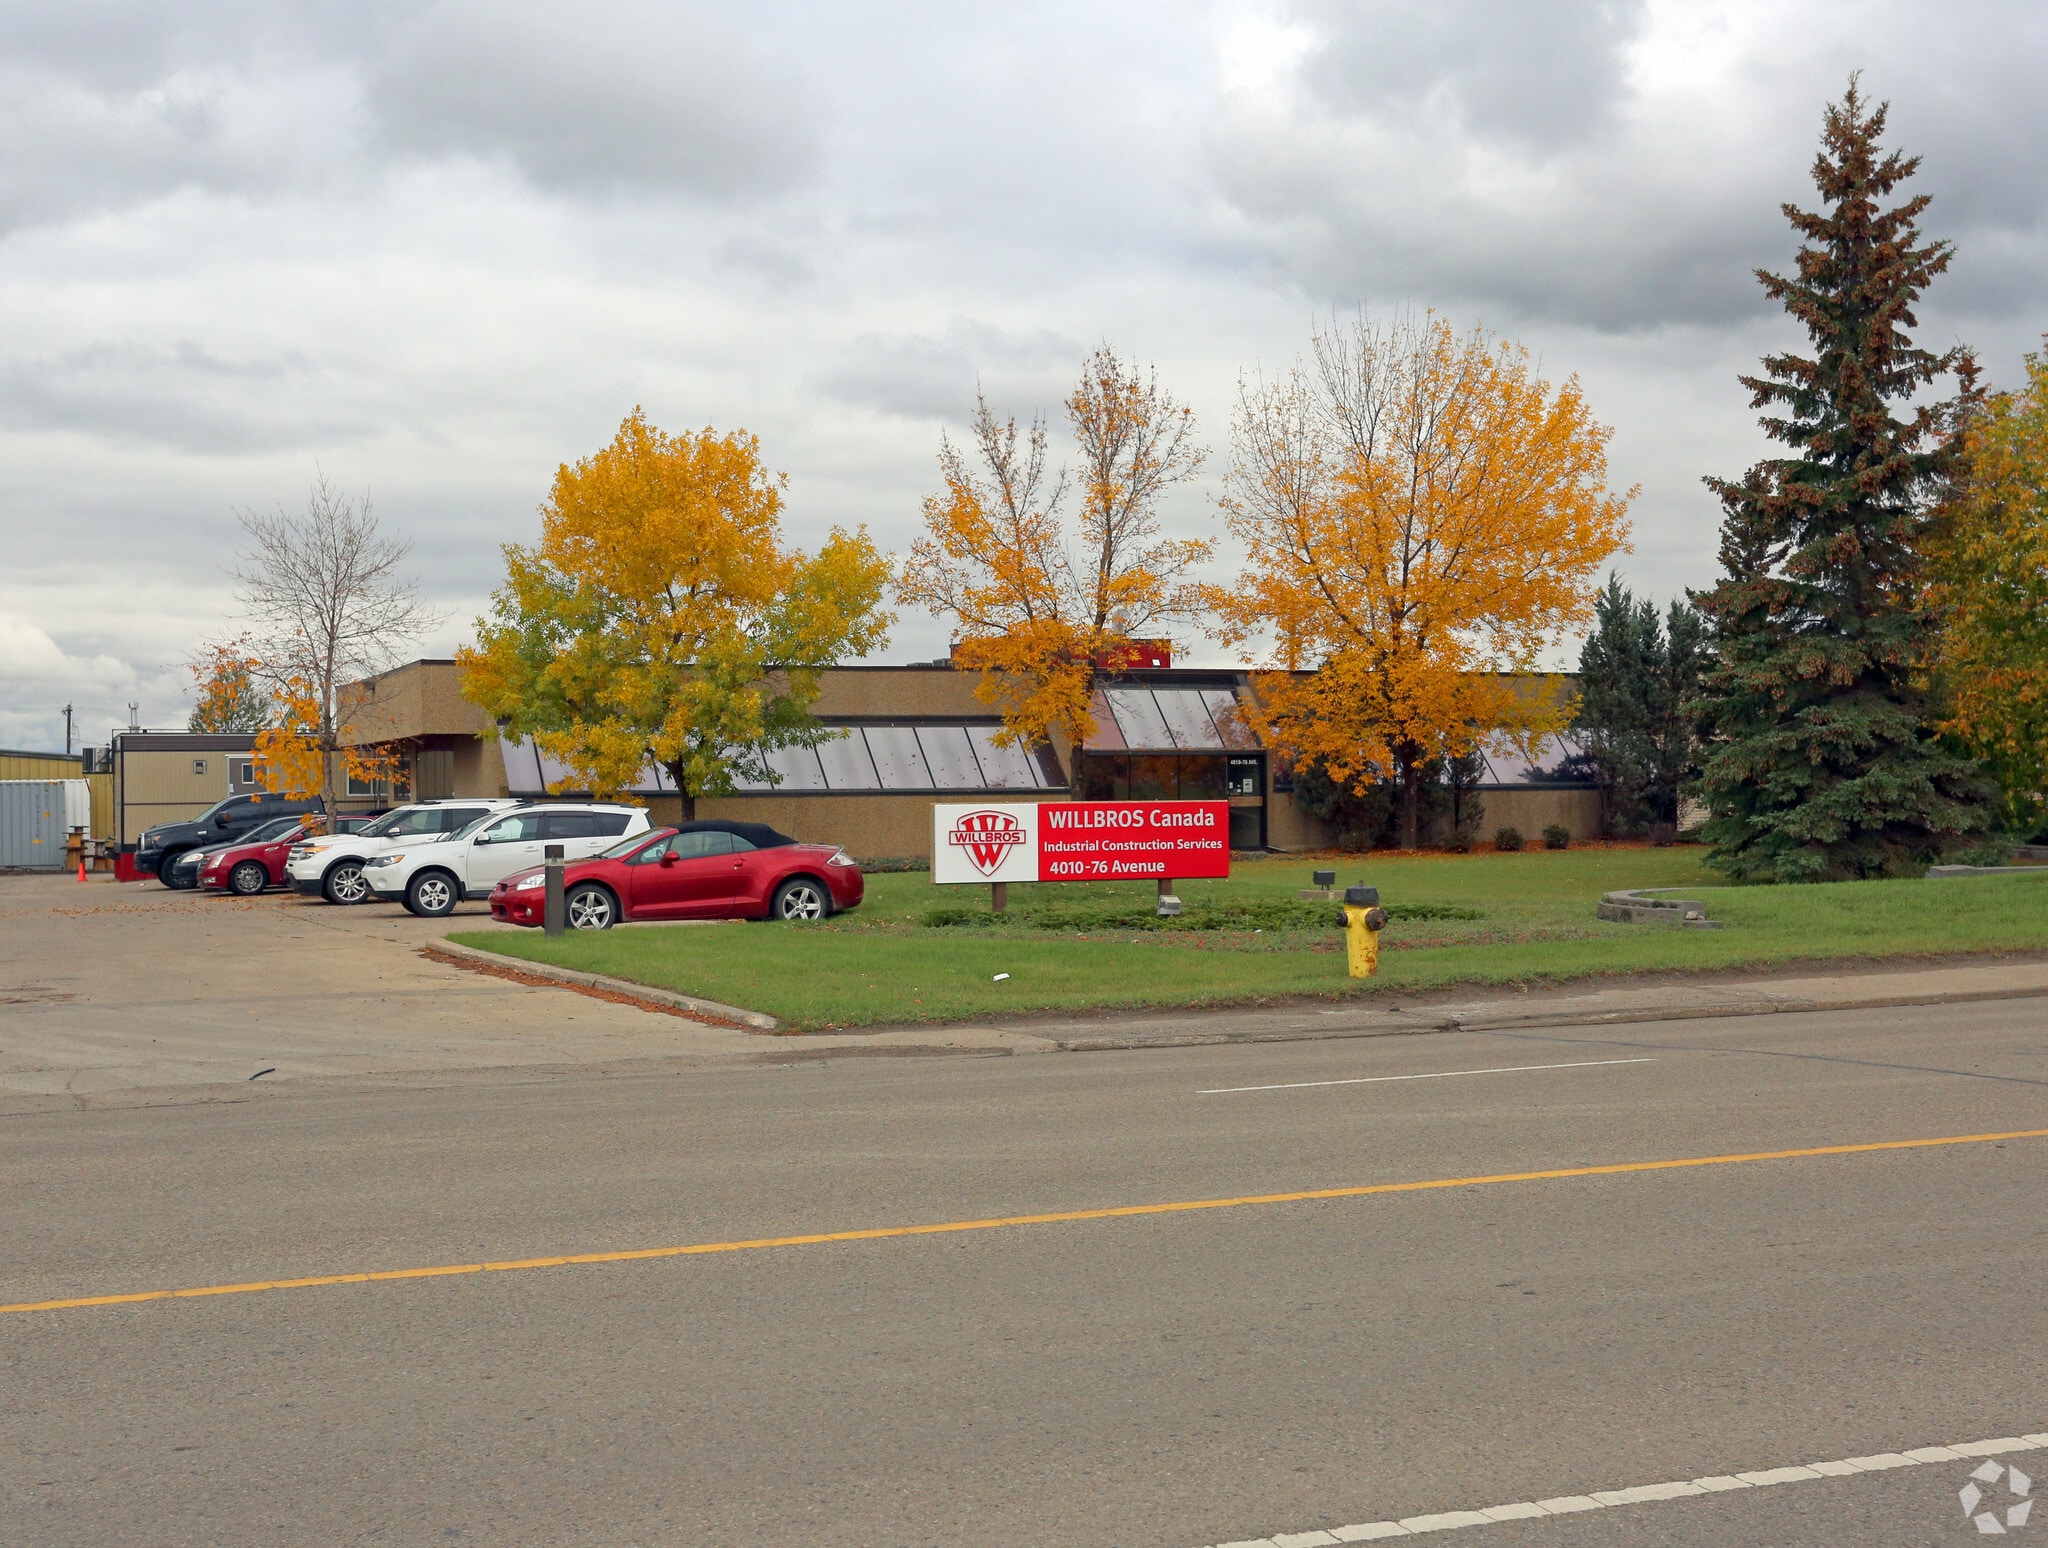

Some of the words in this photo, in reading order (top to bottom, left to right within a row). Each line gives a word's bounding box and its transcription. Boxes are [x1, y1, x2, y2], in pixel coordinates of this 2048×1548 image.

[1049, 810, 1144, 828] WILLBROS
[1150, 808, 1214, 827] Canada
[955, 832, 1020, 842] WILLBROS
[1044, 840, 1099, 852] Industrial
[1102, 840, 1174, 851] Construction
[1177, 838, 1222, 850] Services
[1050, 860, 1108, 874] 4010-76
[1112, 860, 1165, 873] Avenue
